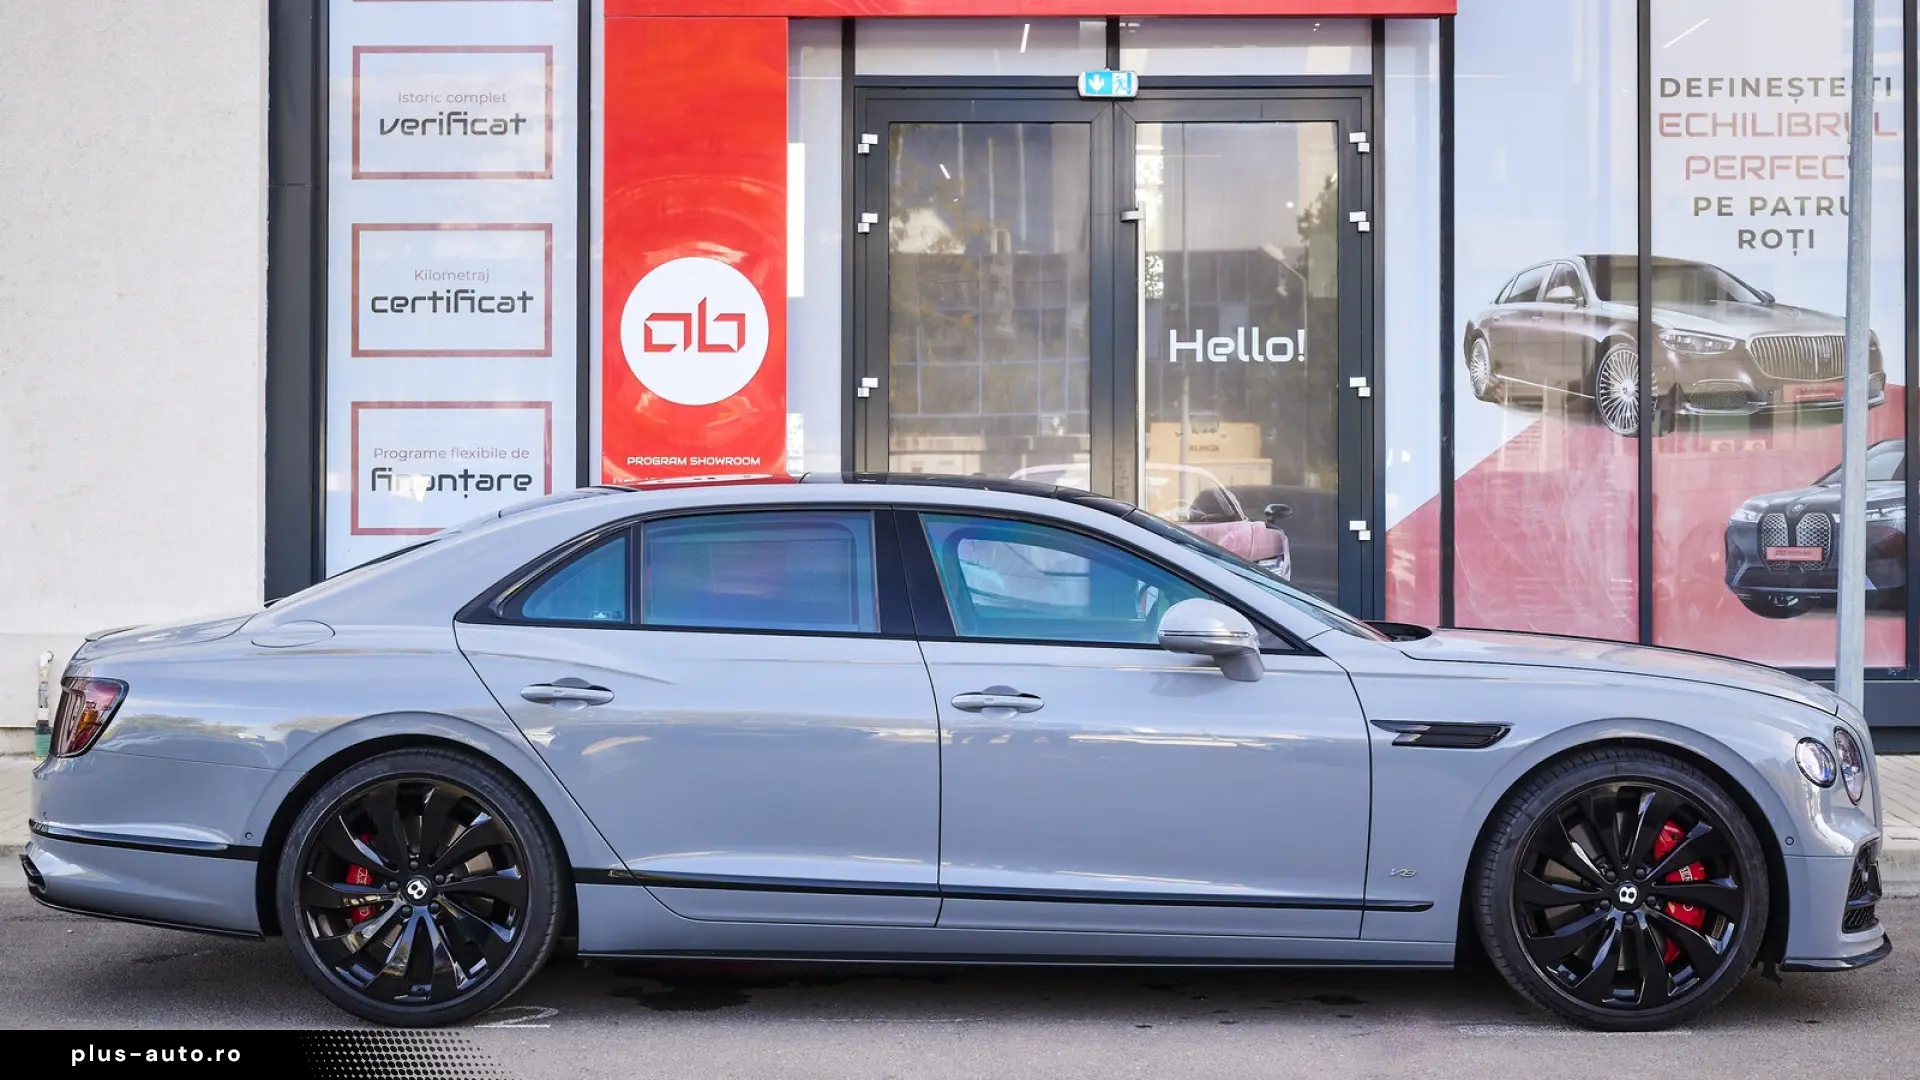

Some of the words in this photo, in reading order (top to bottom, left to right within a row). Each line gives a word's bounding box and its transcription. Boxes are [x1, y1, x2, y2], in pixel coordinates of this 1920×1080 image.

[398, 91, 442, 104] Istoric
[446, 91, 507, 106] complet
[379, 111, 527, 136] verificat
[1658, 112, 1898, 138] ECHILIBRL
[1685, 154, 1849, 181] PERFEC
[1693, 196, 1734, 217] PE
[1738, 228, 1814, 257] ROȚI
[414, 268, 490, 283] Kilometraj
[371, 288, 534, 314] certificat
[1169, 327, 1306, 363] Hello!
[373, 447, 447, 462] Programe
[450, 446, 507, 459] flexibile
[511, 447, 530, 459] de
[627, 456, 687, 466] PROGRAM
[689, 456, 761, 466] SHOWROOM
